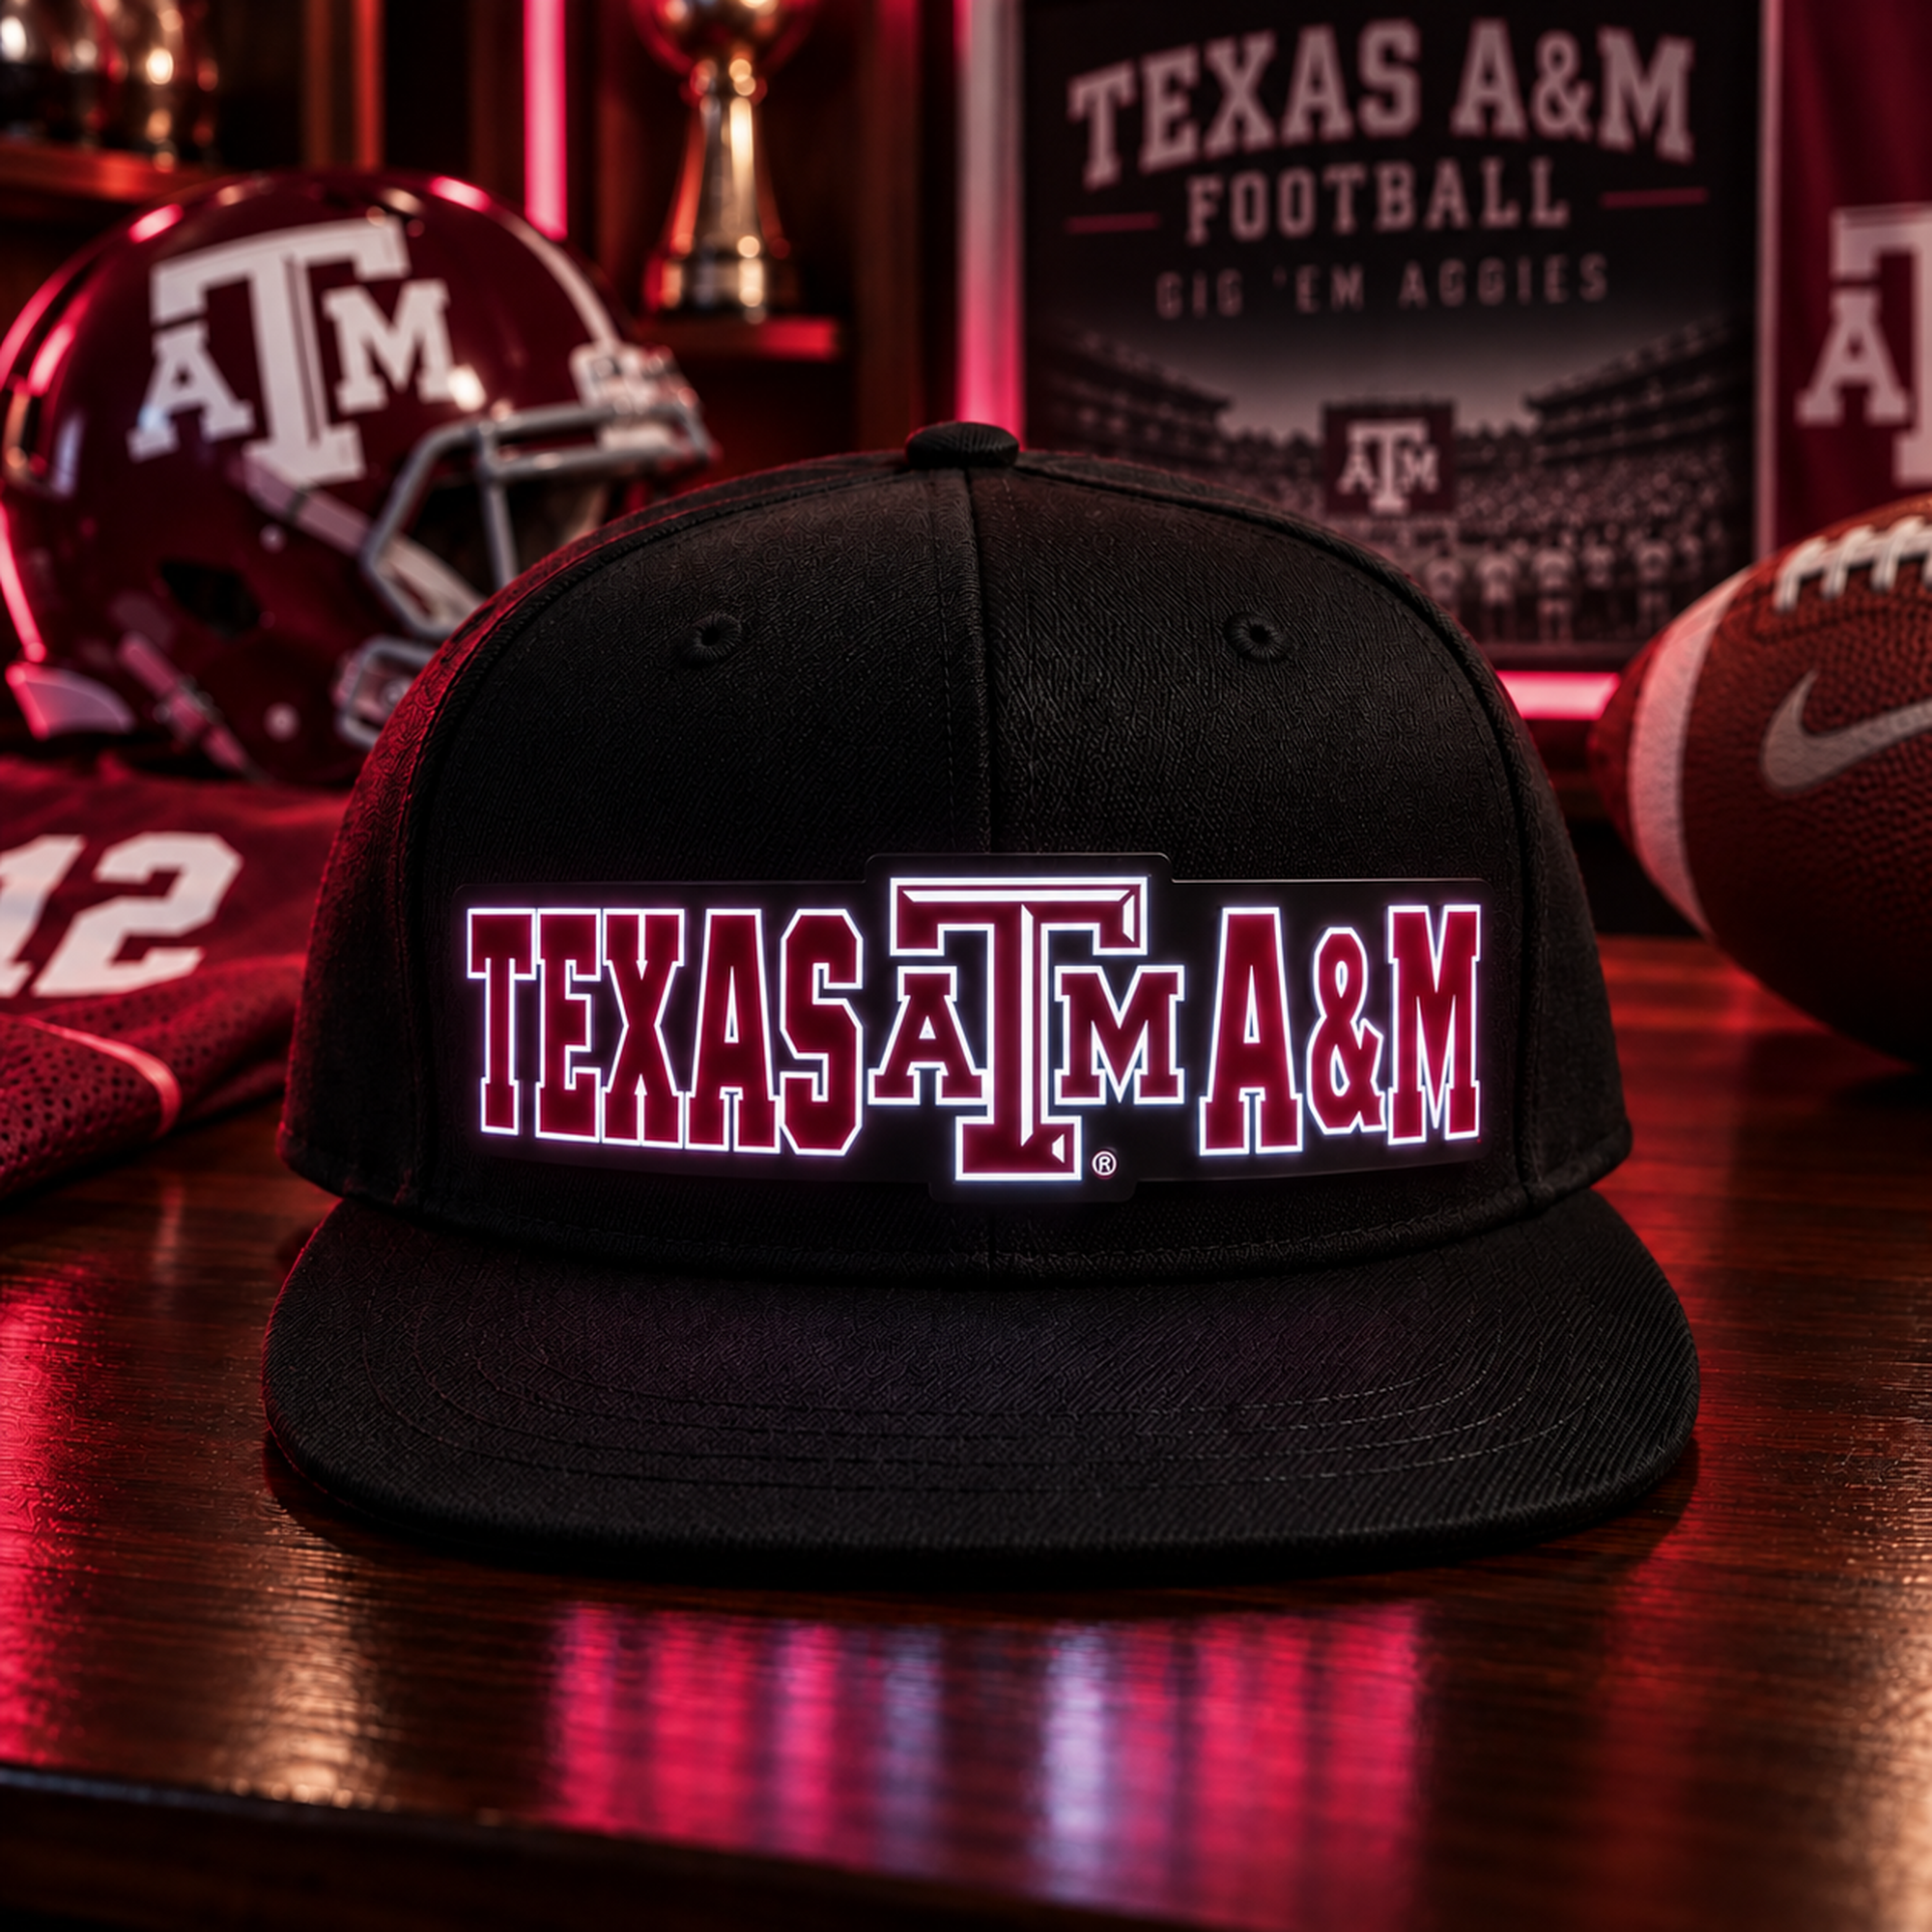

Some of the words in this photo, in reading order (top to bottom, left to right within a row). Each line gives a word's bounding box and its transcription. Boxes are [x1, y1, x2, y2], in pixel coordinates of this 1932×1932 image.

[1066, 17, 1422, 190] TEXAS
[1451, 16, 1695, 165] A&M
[1185, 156, 1570, 246] FOOTBALL
[1155, 267, 1245, 321] GIG
[1272, 263, 1366, 315] 'EM
[1397, 251, 1608, 310] AGGIES
[0, 832, 243, 998] 12
[468, 907, 864, 1156] TEXAS
[1199, 904, 1481, 1155] A&M
